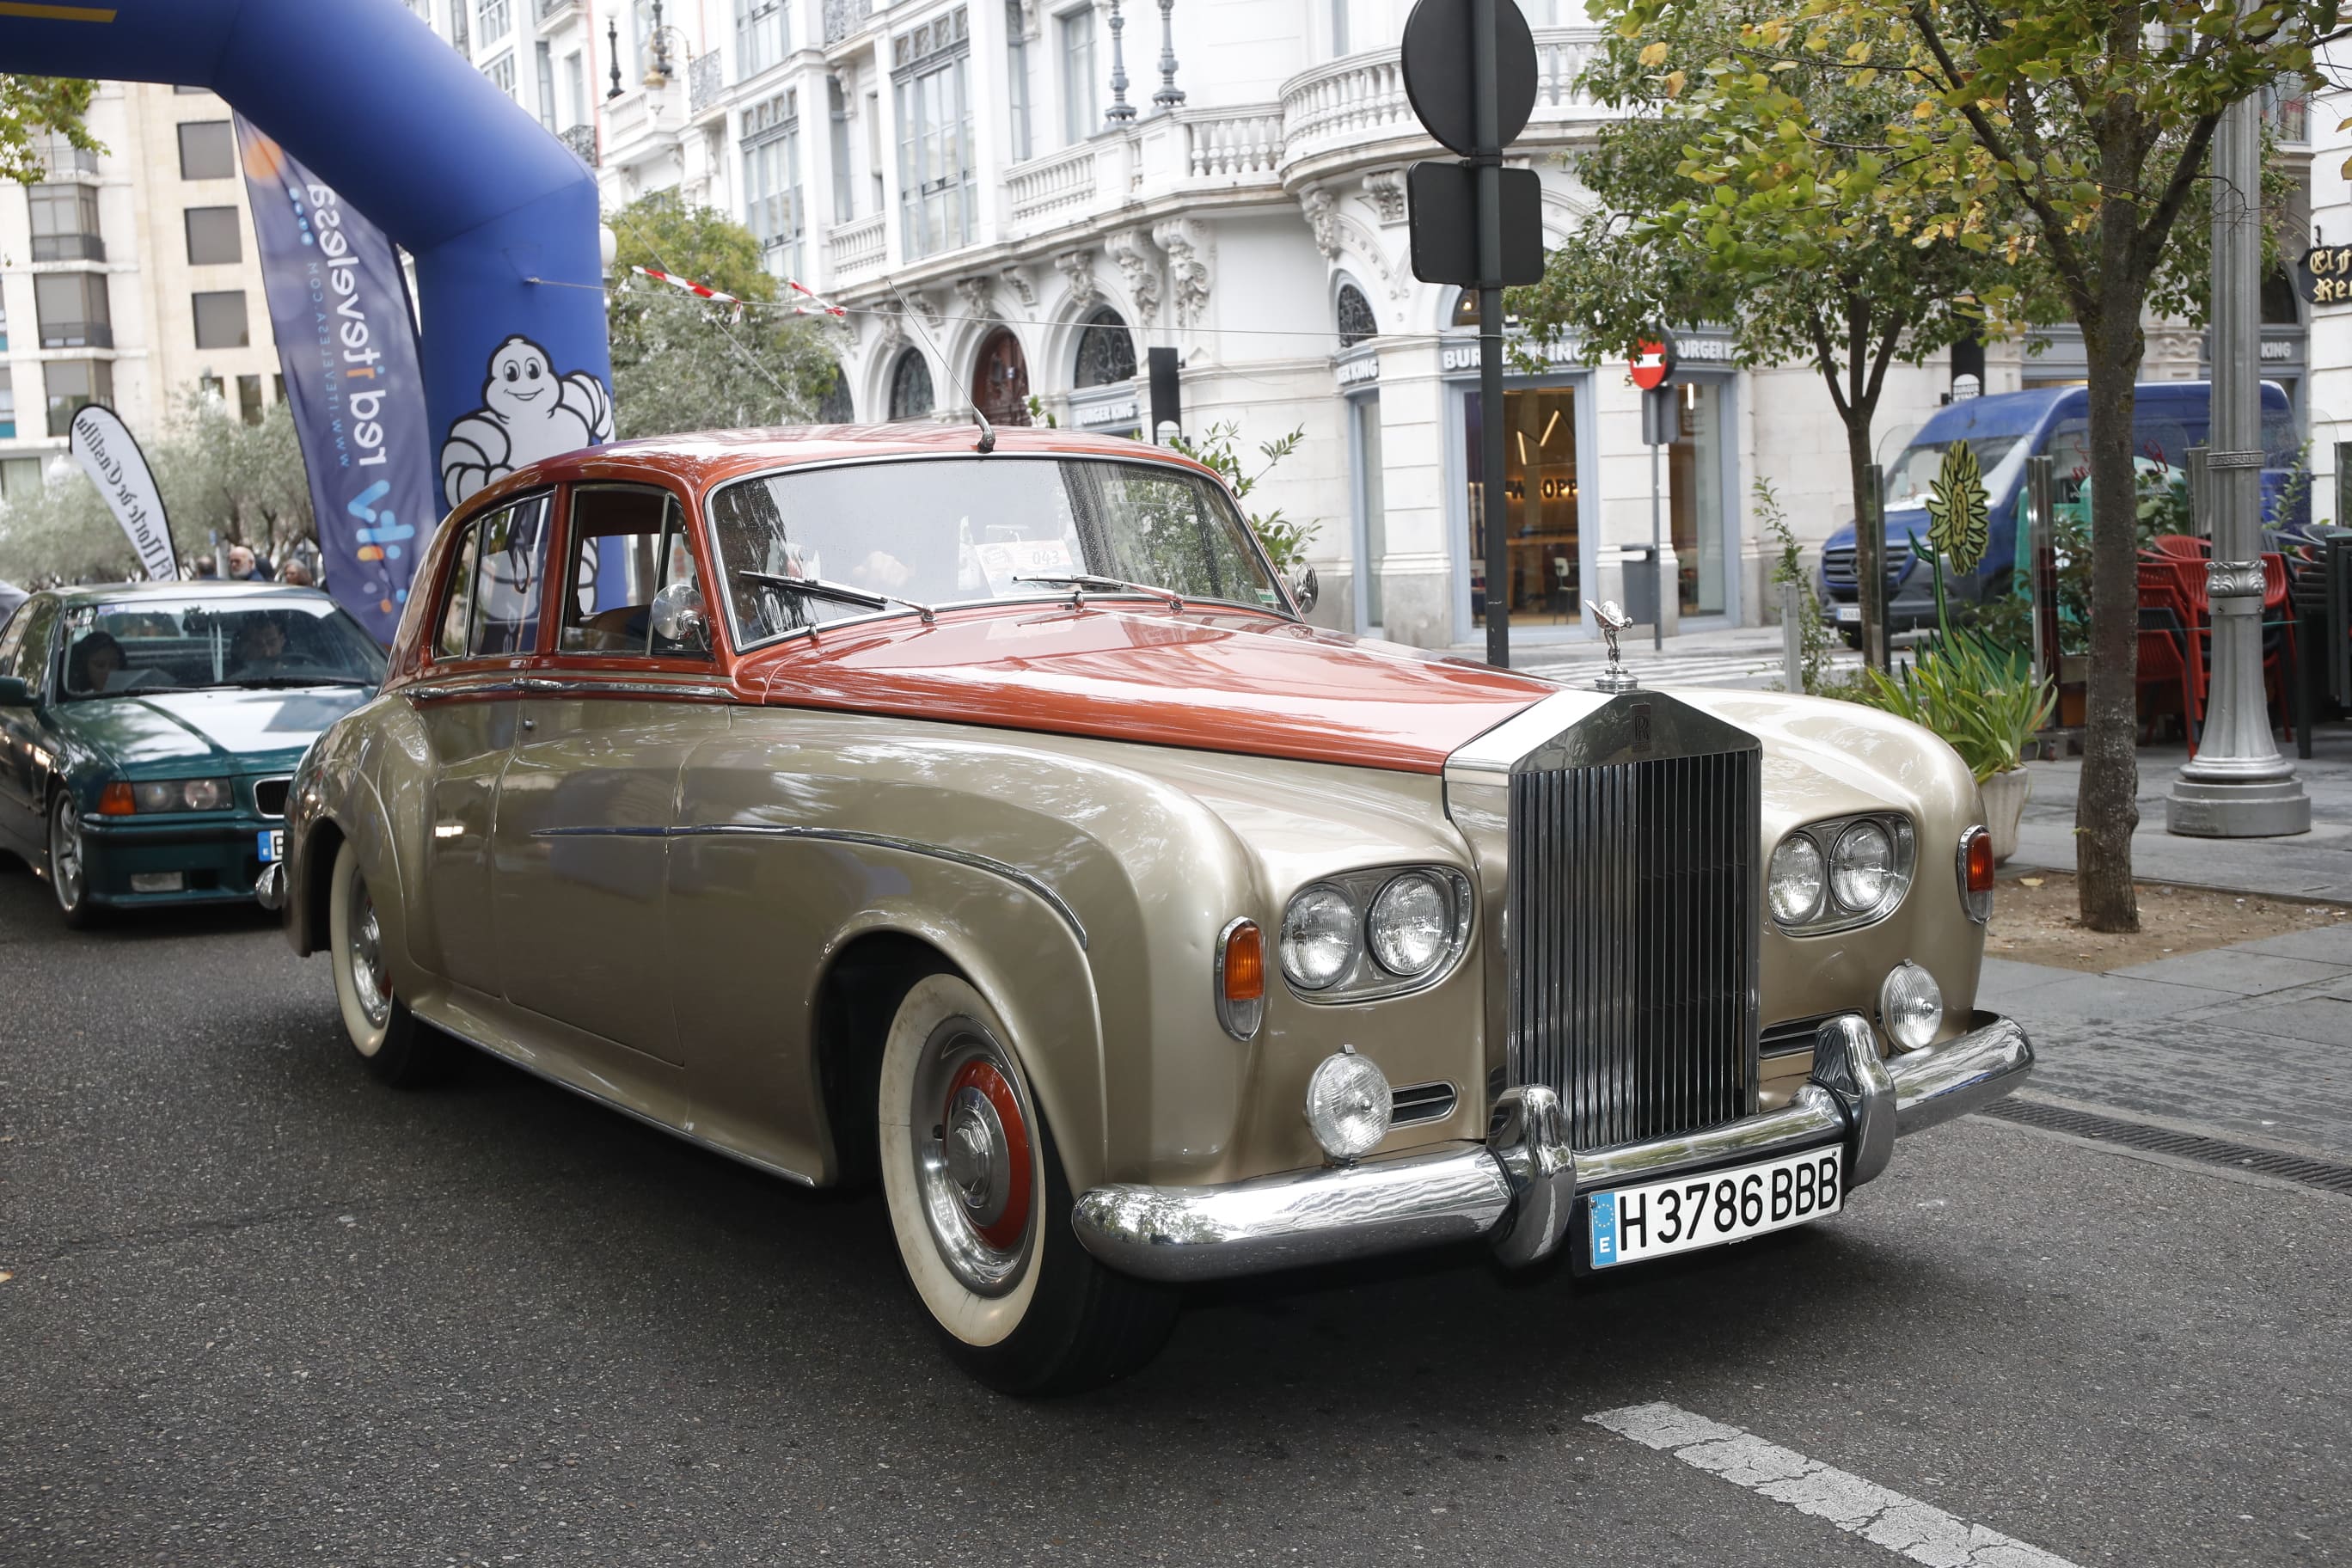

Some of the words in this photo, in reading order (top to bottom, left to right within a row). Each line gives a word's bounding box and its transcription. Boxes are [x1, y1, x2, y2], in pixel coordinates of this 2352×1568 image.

[2312, 278, 2352, 302] Re
[2260, 341, 2291, 358] KING
[1351, 358, 1378, 380] KING
[1032, 549, 1060, 565] 043
[1599, 1236, 1611, 1253] E
